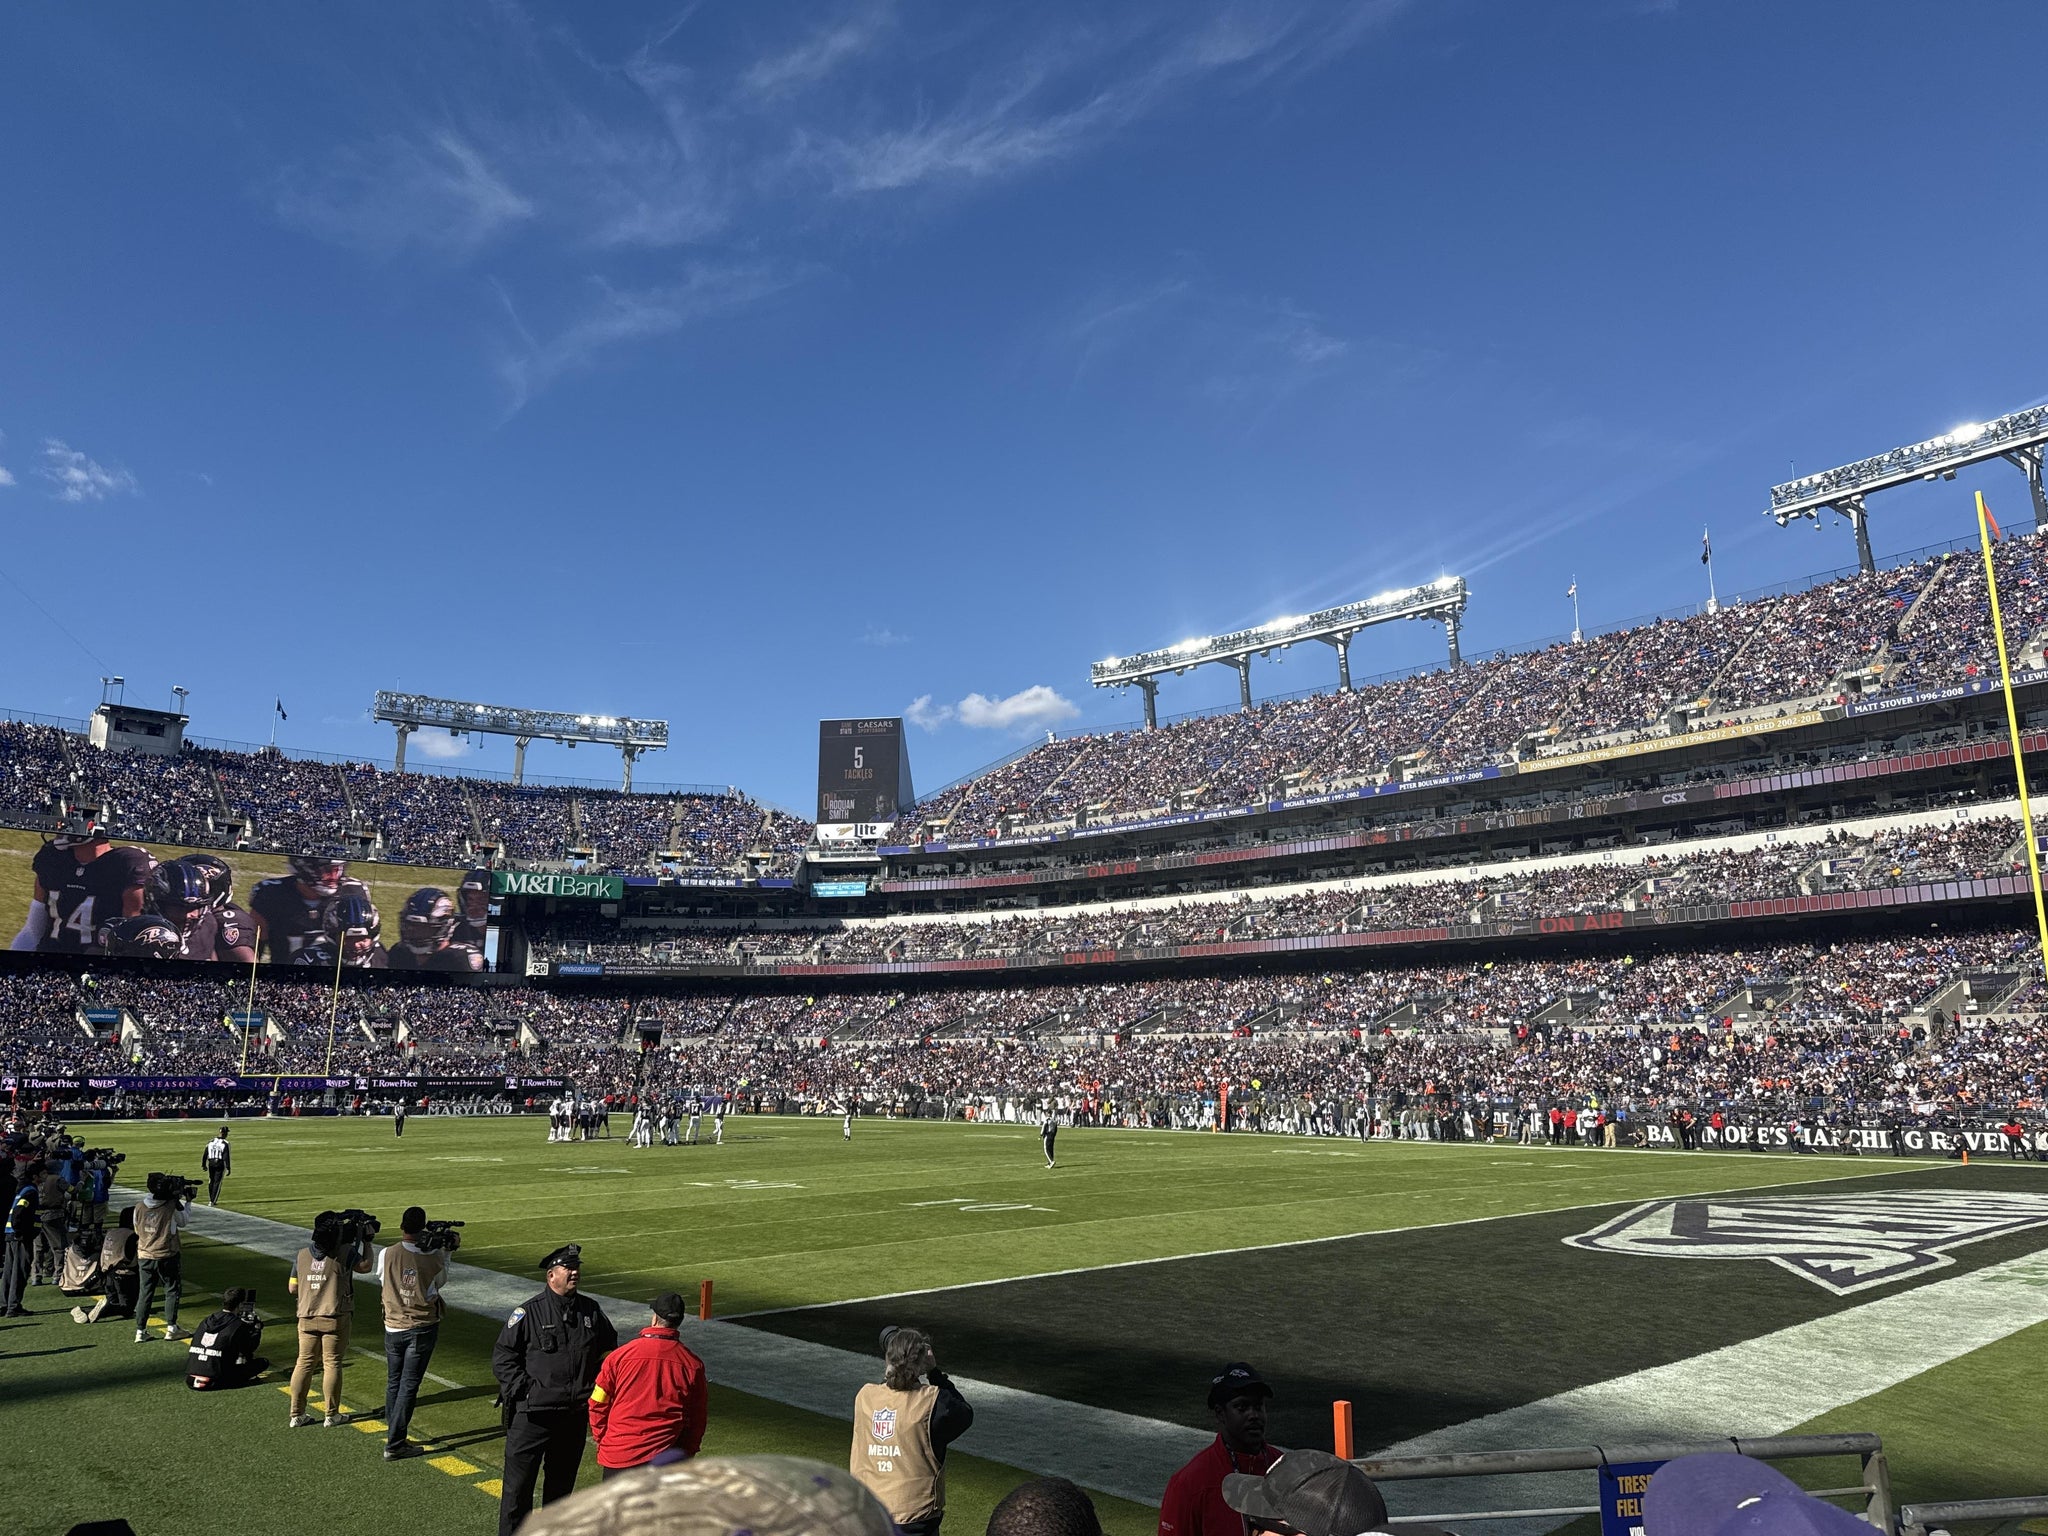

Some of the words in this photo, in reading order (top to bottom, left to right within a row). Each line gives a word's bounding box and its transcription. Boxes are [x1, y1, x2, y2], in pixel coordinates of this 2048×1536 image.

[2023, 671, 2048, 683] LEWI
[1854, 702, 1878, 714] MATT
[1880, 696, 1914, 708] STOVER
[1916, 687, 1964, 703] 1996-2008
[857, 721, 893, 729] CAESARS
[1741, 724, 1753, 734] ED
[1754, 721, 1775, 733] REED
[1777, 713, 1822, 729] 2002-2012
[1643, 742, 1657, 751] RAY
[1659, 737, 1683, 749] LEWIS
[1685, 730, 1726, 745] 1996-2012
[854, 746, 863, 769] 5
[1529, 757, 1564, 770] JONATHAN
[1565, 753, 1591, 766] OGDEN
[1593, 747, 1631, 761] 1996-2007
[844, 768, 873, 780] TACKLES
[1400, 782, 1416, 791] PETER
[1417, 776, 1450, 788] BOULWARE
[1451, 771, 1483, 784] 1997-2005
[1283, 799, 1305, 808] MICHAEL
[1662, 792, 1687, 804] CSX
[829, 800, 855, 811] ROQUAN
[1228, 808, 1248, 816] MODELL
[1567, 806, 1584, 819] 7:42
[1586, 804, 1601, 817] QTR
[1602, 803, 1607, 815] 2
[828, 810, 849, 820] SMITH
[1506, 816, 1515, 827] 10
[1516, 813, 1532, 826] BALL
[1532, 811, 1542, 824] ON
[854, 823, 877, 838] Lite
[1451, 823, 1456, 834] 7
[1394, 830, 1400, 842] 6
[1088, 865, 1109, 878] ON
[1113, 862, 1137, 875] AIR
[505, 873, 561, 895] M&T
[561, 876, 611, 898] Bank
[48, 890, 97, 944] 14
[1539, 917, 1575, 934] ON
[1583, 912, 1624, 931] AIR
[1064, 953, 1086, 965] ON
[1091, 950, 1116, 963] AIR
[534, 964, 547, 974] 20
[560, 966, 600, 974] PROGRESSIVE
[88, 1078, 117, 1088] RAVENS
[326, 1079, 350, 1088] RAVENS
[428, 1103, 513, 1115] MARYLAND
[1647, 1125, 1788, 1145] BAMOE'S
[1803, 1127, 1924, 1149] ARCHIG
[1930, 1130, 2033, 1152] RVEN
[205, 1348, 222, 1357] MEDIA
[875, 1421, 892, 1436] NFL
[868, 1444, 901, 1457] MEDIA
[877, 1461, 892, 1472] 129
[1616, 1498, 1645, 1518] FIEL
